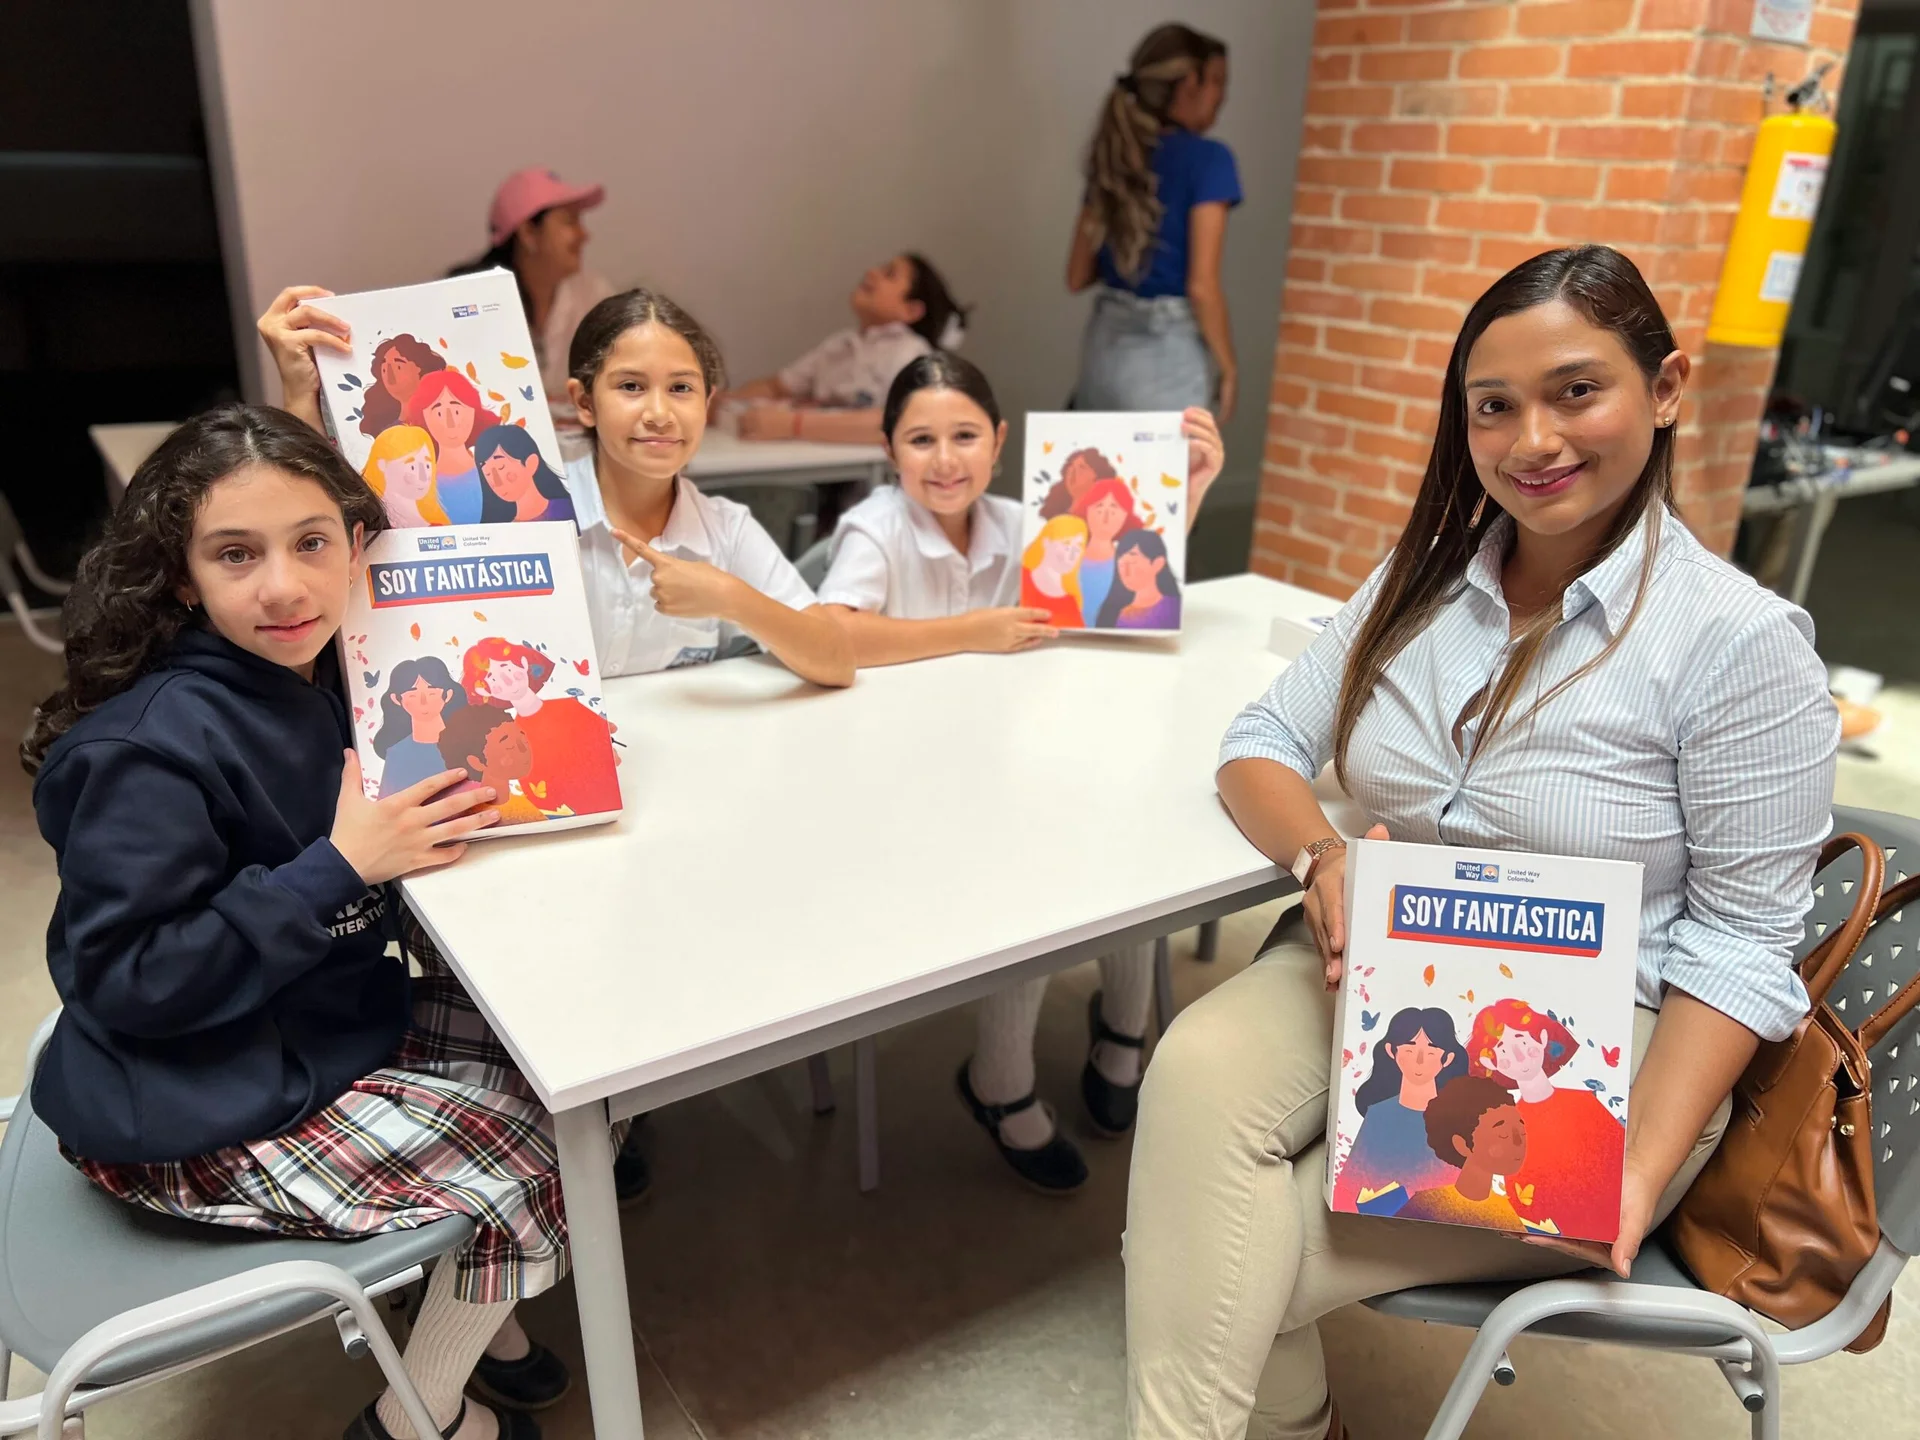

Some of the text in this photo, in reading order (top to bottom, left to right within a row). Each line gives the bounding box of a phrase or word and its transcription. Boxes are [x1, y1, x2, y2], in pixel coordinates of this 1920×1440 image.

[419, 537, 440, 545] United
[379, 558, 549, 596] SOY FANTÁSTICA
[1456, 863, 1481, 872] United
[1465, 870, 1481, 881] Way
[1507, 868, 1541, 878] United Way
[1507, 875, 1535, 883] Colombia
[1401, 893, 1597, 943] SOY FANTÁSTICA
